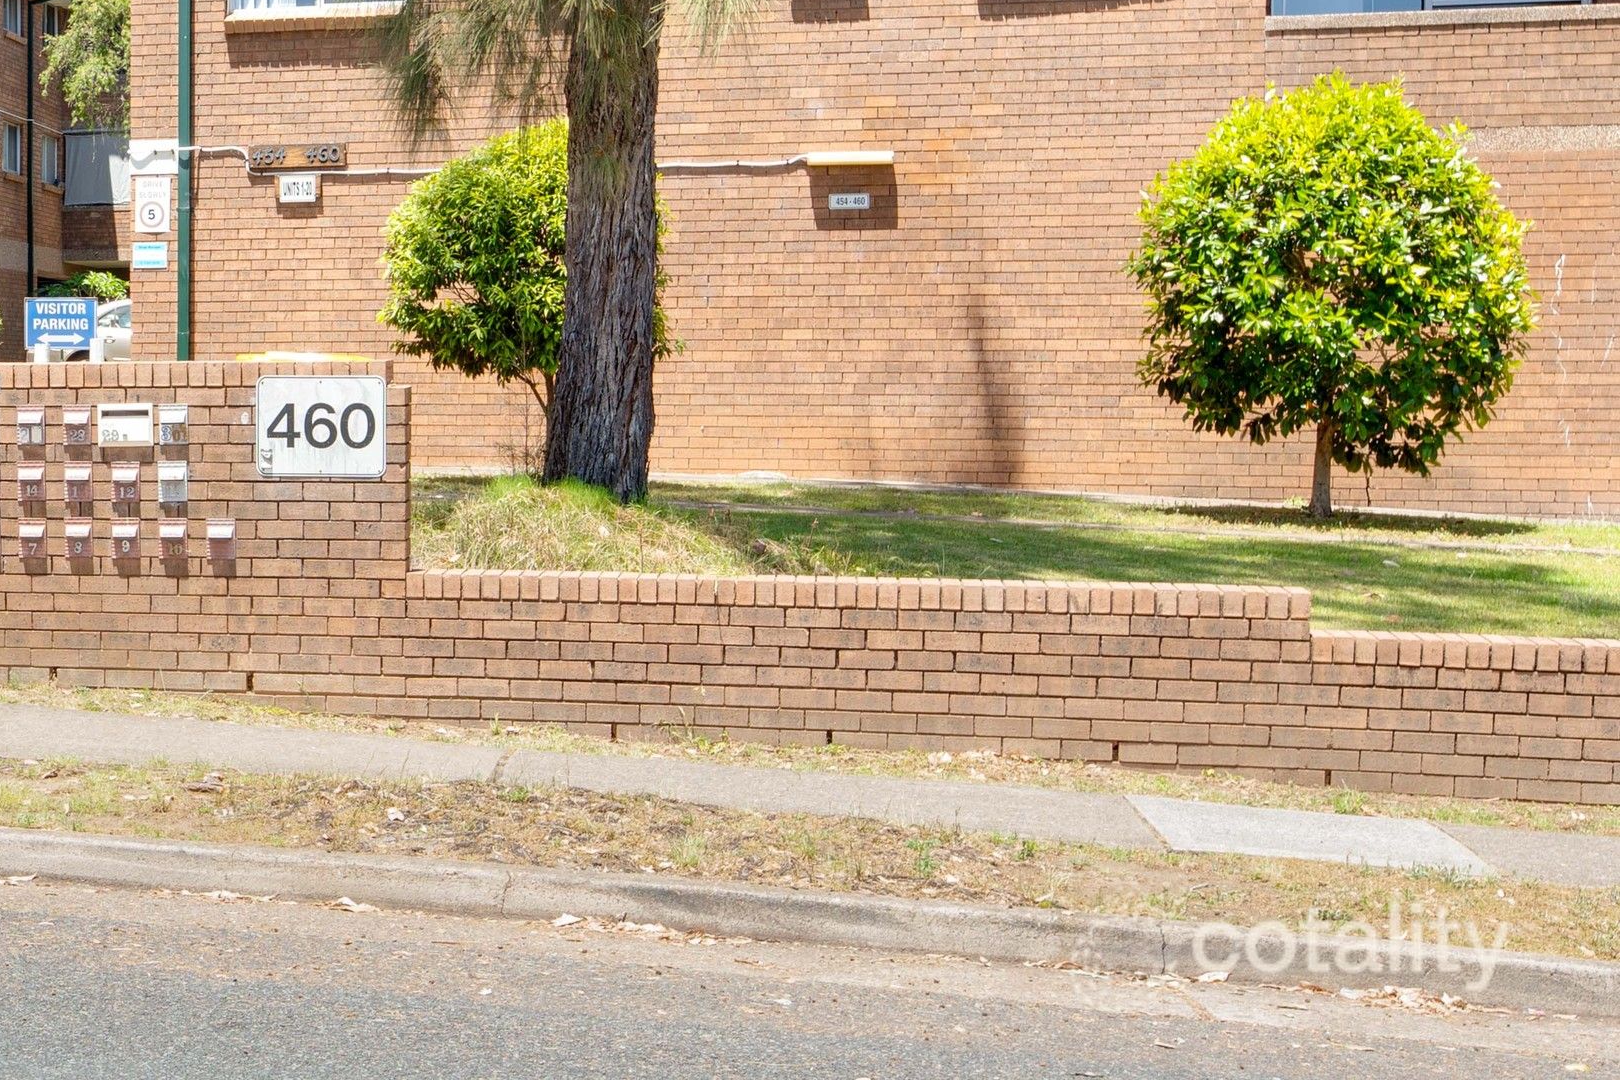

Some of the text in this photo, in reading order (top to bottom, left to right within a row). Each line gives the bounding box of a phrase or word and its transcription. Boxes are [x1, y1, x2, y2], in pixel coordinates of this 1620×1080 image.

[253, 145, 340, 166] 454 460
[282, 181, 312, 196] UNITS 1-20
[835, 197, 848, 206] 454
[853, 196, 866, 206] 460
[148, 209, 156, 220] 5
[35, 302, 87, 314] VISITOR
[33, 317, 89, 330] PARKING
[266, 402, 376, 449] 460
[119, 486, 135, 499] 12
[28, 542, 37, 555] 7
[73, 542, 82, 554] 8
[121, 540, 130, 553] 9
